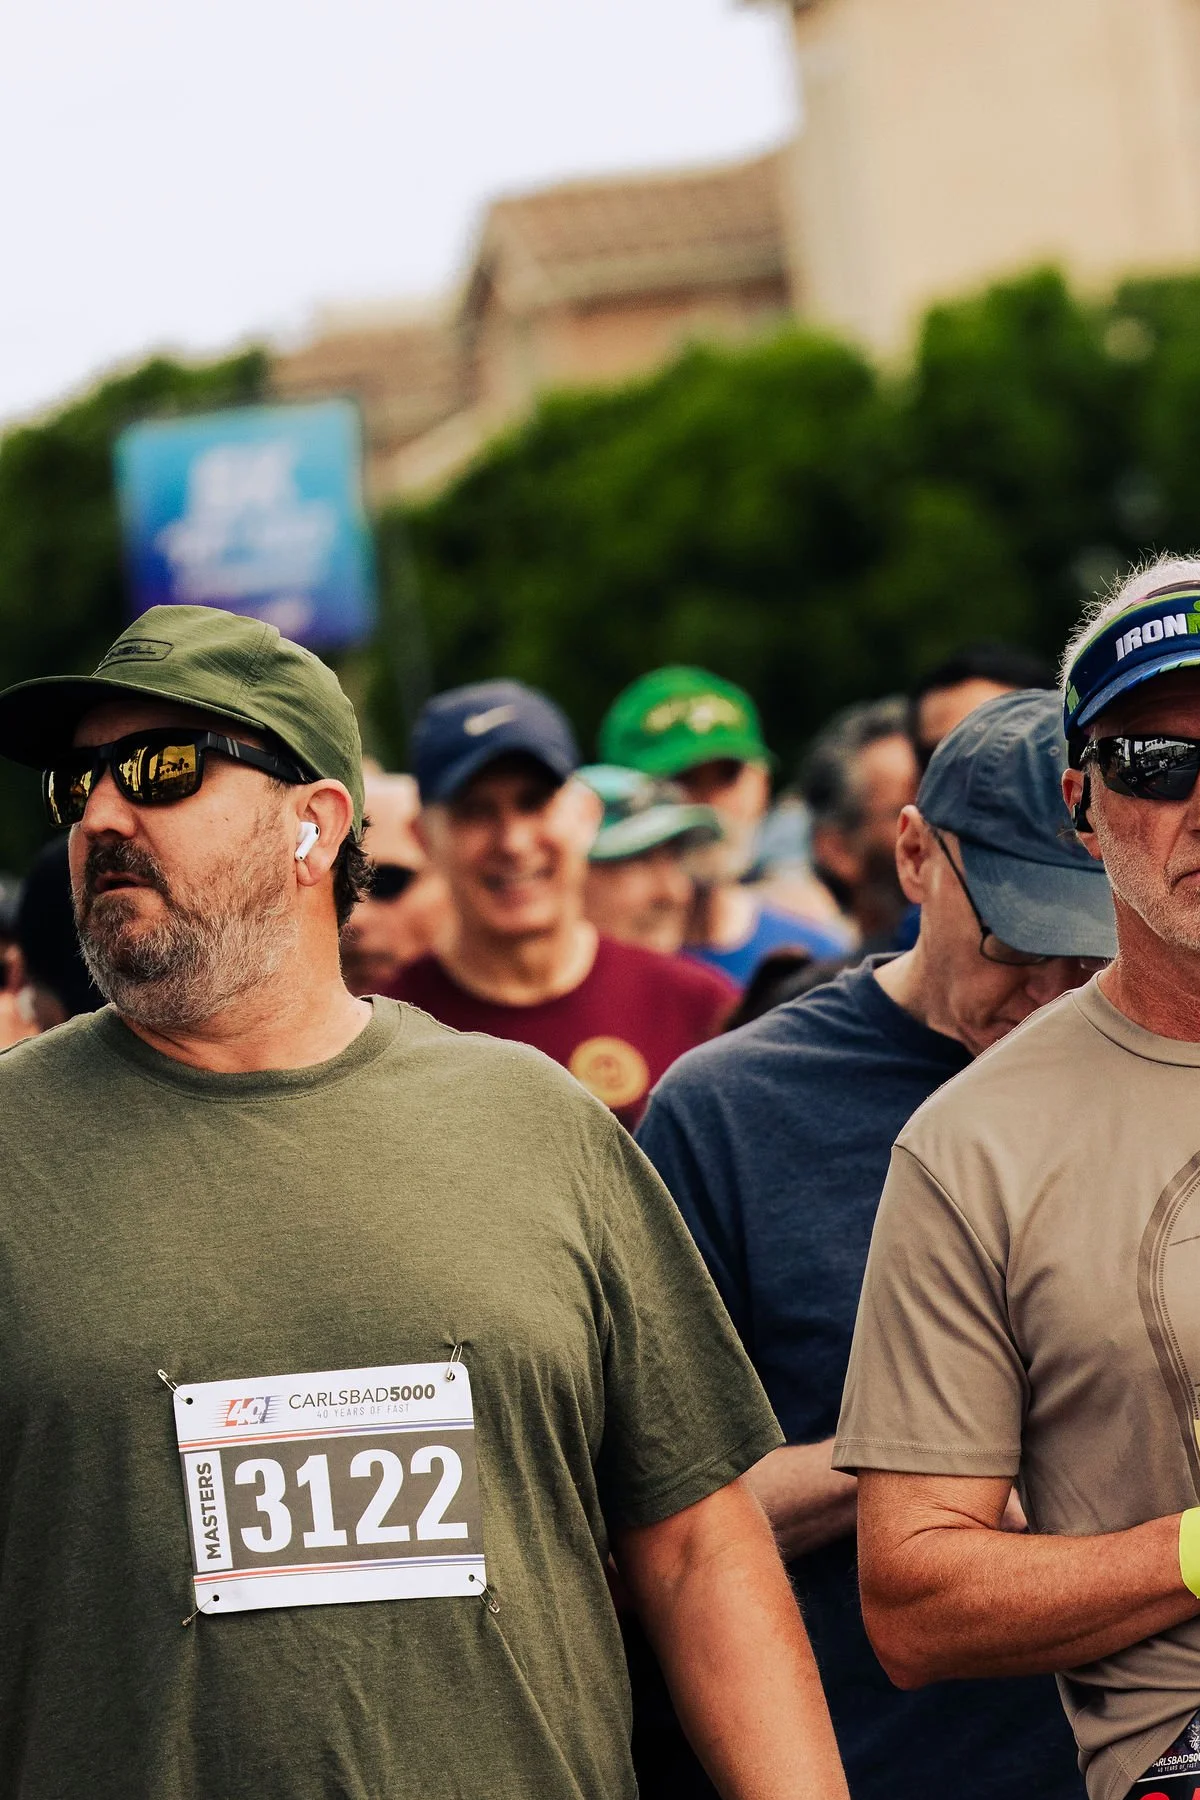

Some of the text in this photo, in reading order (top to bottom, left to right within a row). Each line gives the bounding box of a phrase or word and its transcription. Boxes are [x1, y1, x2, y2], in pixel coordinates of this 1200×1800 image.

[288, 1383, 436, 1410] CARLSBAD5000
[316, 1403, 410, 1419] 40 YEARS OF FAST
[196, 1462, 222, 1561] MASTERS
[234, 1445, 469, 1554] 3122
